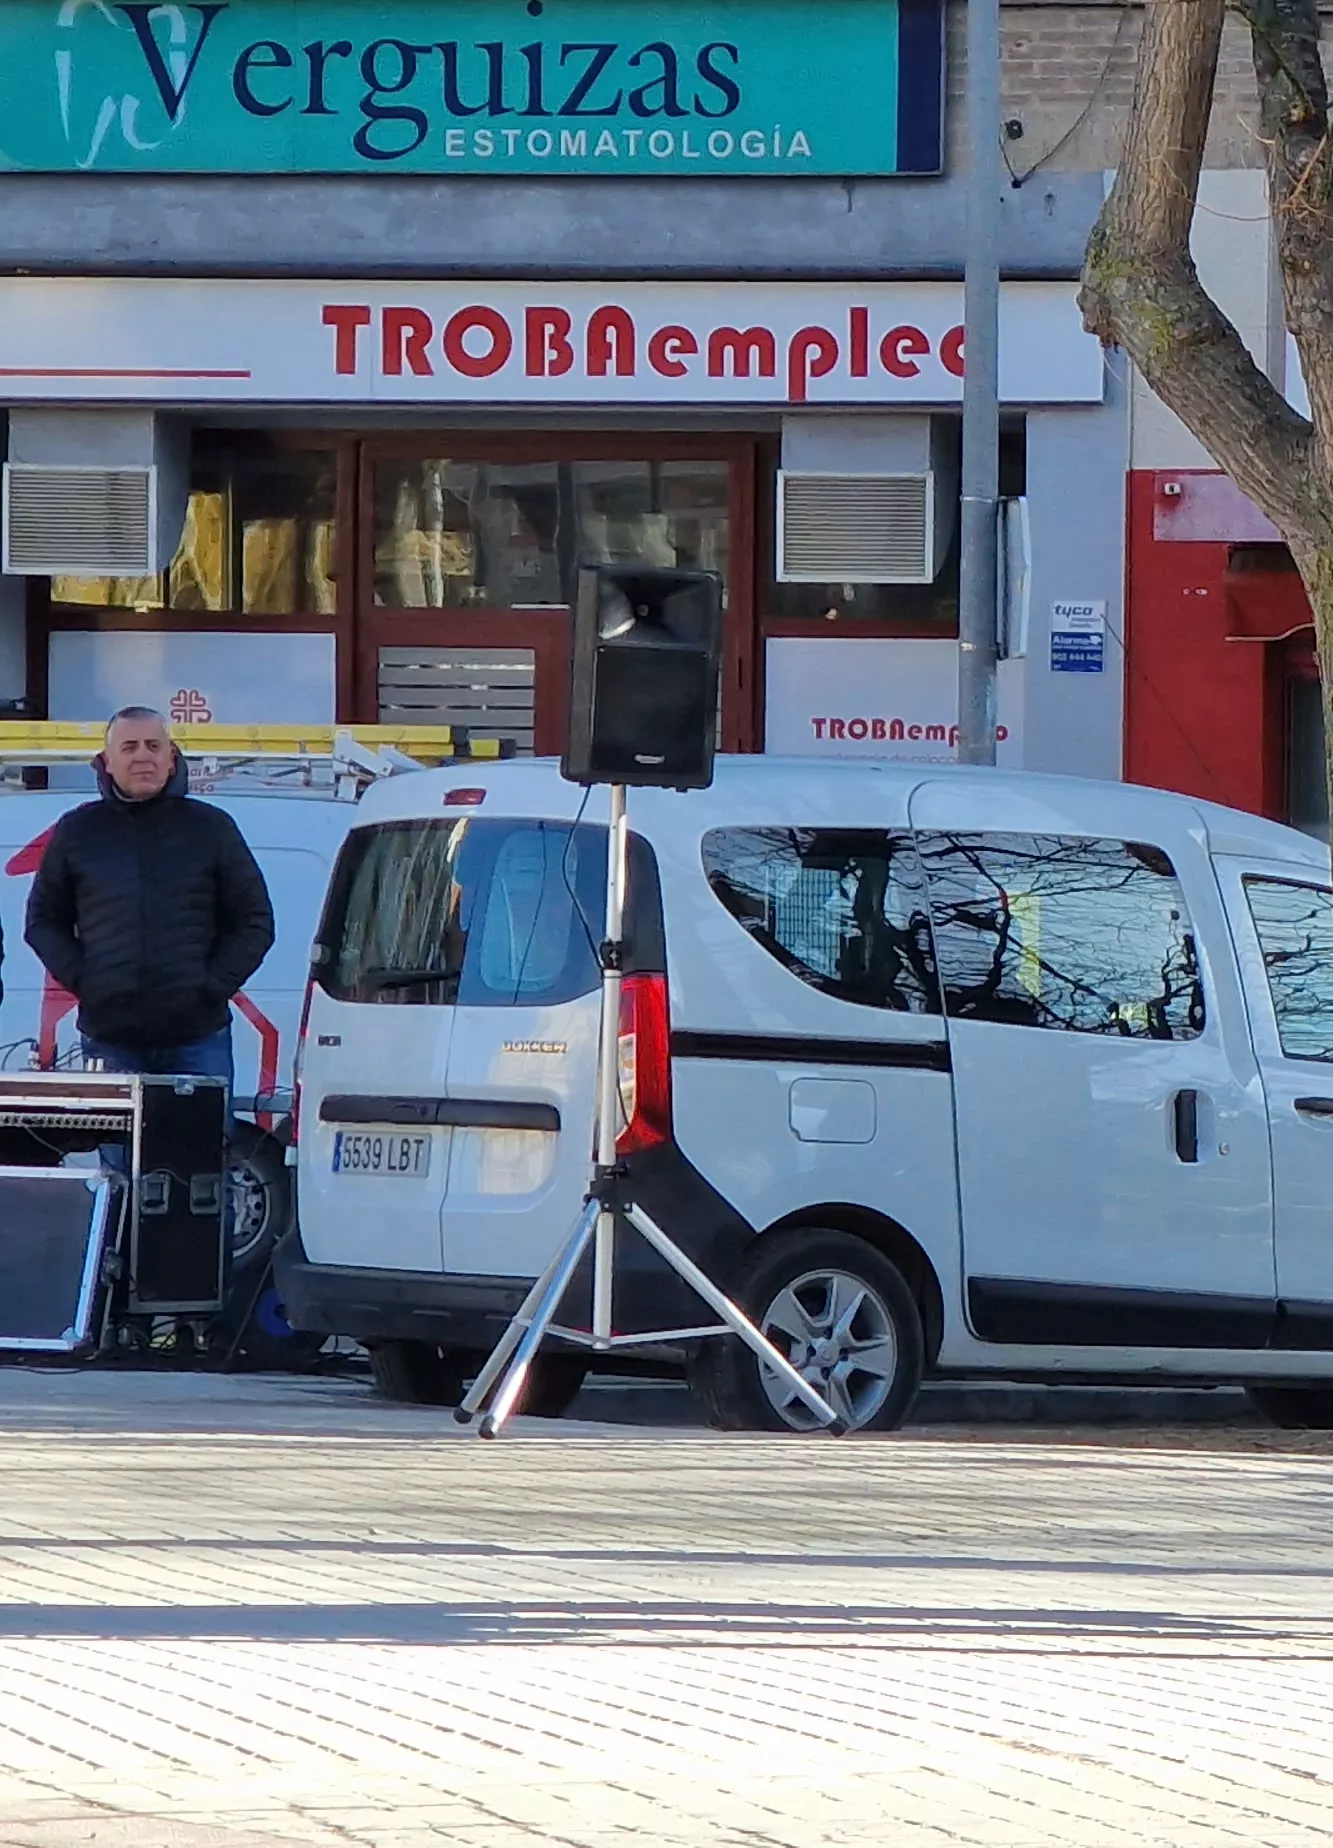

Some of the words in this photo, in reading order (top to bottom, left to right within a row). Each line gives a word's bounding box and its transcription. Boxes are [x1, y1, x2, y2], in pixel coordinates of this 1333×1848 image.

[113, 0, 742, 161] Verguizas
[445, 126, 813, 158] ESTOMATOLOGÍA
[1055, 604, 1093, 618] tyco
[812, 718, 1009, 747] TROBAempo
[343, 1136, 382, 1169] 5539
[387, 1138, 425, 1172] LBT
